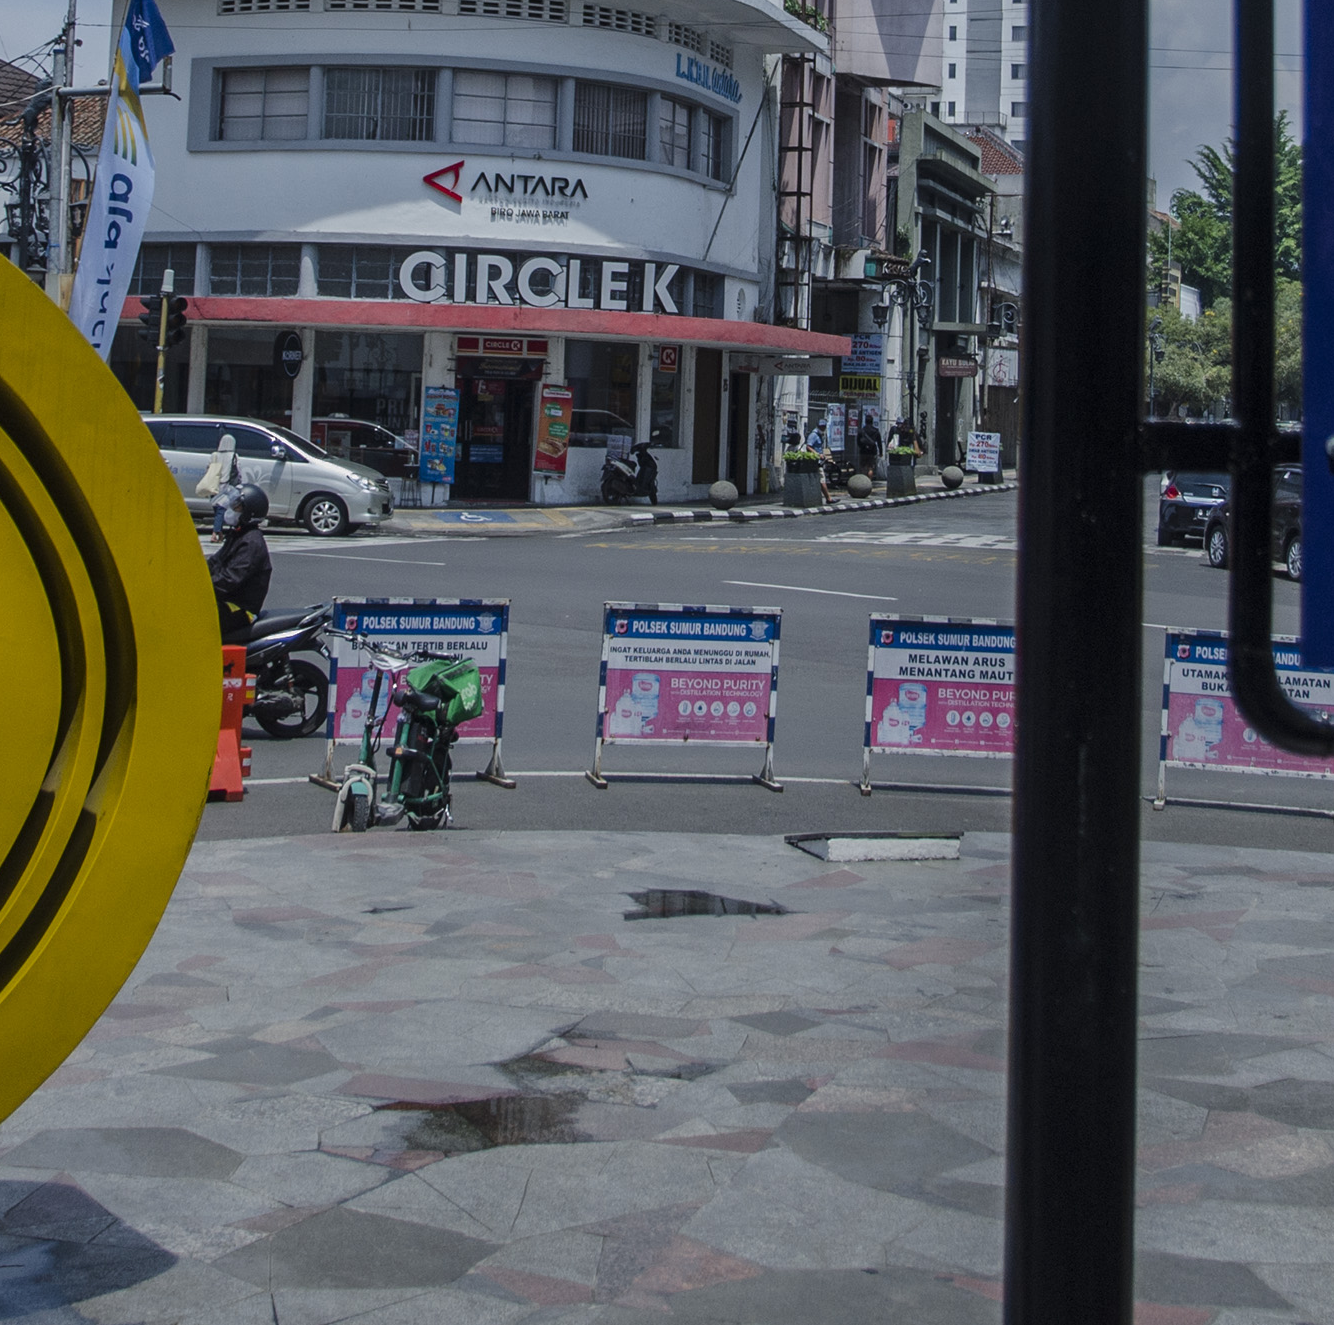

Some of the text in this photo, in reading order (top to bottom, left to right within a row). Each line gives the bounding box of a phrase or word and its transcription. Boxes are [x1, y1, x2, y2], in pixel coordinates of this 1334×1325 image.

[470, 171, 589, 200] ANTARA
[490, 206, 570, 221] BIRO JAWA BARAT
[398, 250, 680, 314] CIRCLE K
[485, 341, 510, 350] CIRCLE
[841, 377, 879, 391] DIJUAL
[975, 433, 992, 441] PCR
[362, 616, 476, 630] POLSEK SUMUR BANDUNG
[632, 620, 747, 637] POLSEK SUMUR BANDUNG
[410, 641, 488, 651] TERTIB BERLALU
[899, 631, 1016, 648] POLSEK SUMUR BANDUNG
[610, 646, 632, 654] INGAT
[633, 647, 671, 655] KELUARGA
[693, 648, 734, 657] MENUNGGU
[744, 650, 771, 659] RUMAH,
[625, 655, 664, 664] TERTIBLAH
[665, 656, 697, 664] BERLALU
[698, 657, 723, 665] LINTAS
[733, 658, 756, 666] JALAN
[908, 654, 1006, 668] MELAWAN ARUS
[898, 666, 1014, 681] MENANTANG MAUT
[670, 678, 766, 691] BEYOND PURITY
[938, 687, 990, 700] BEYOND
[947, 699, 990, 708] DISTILLATION
